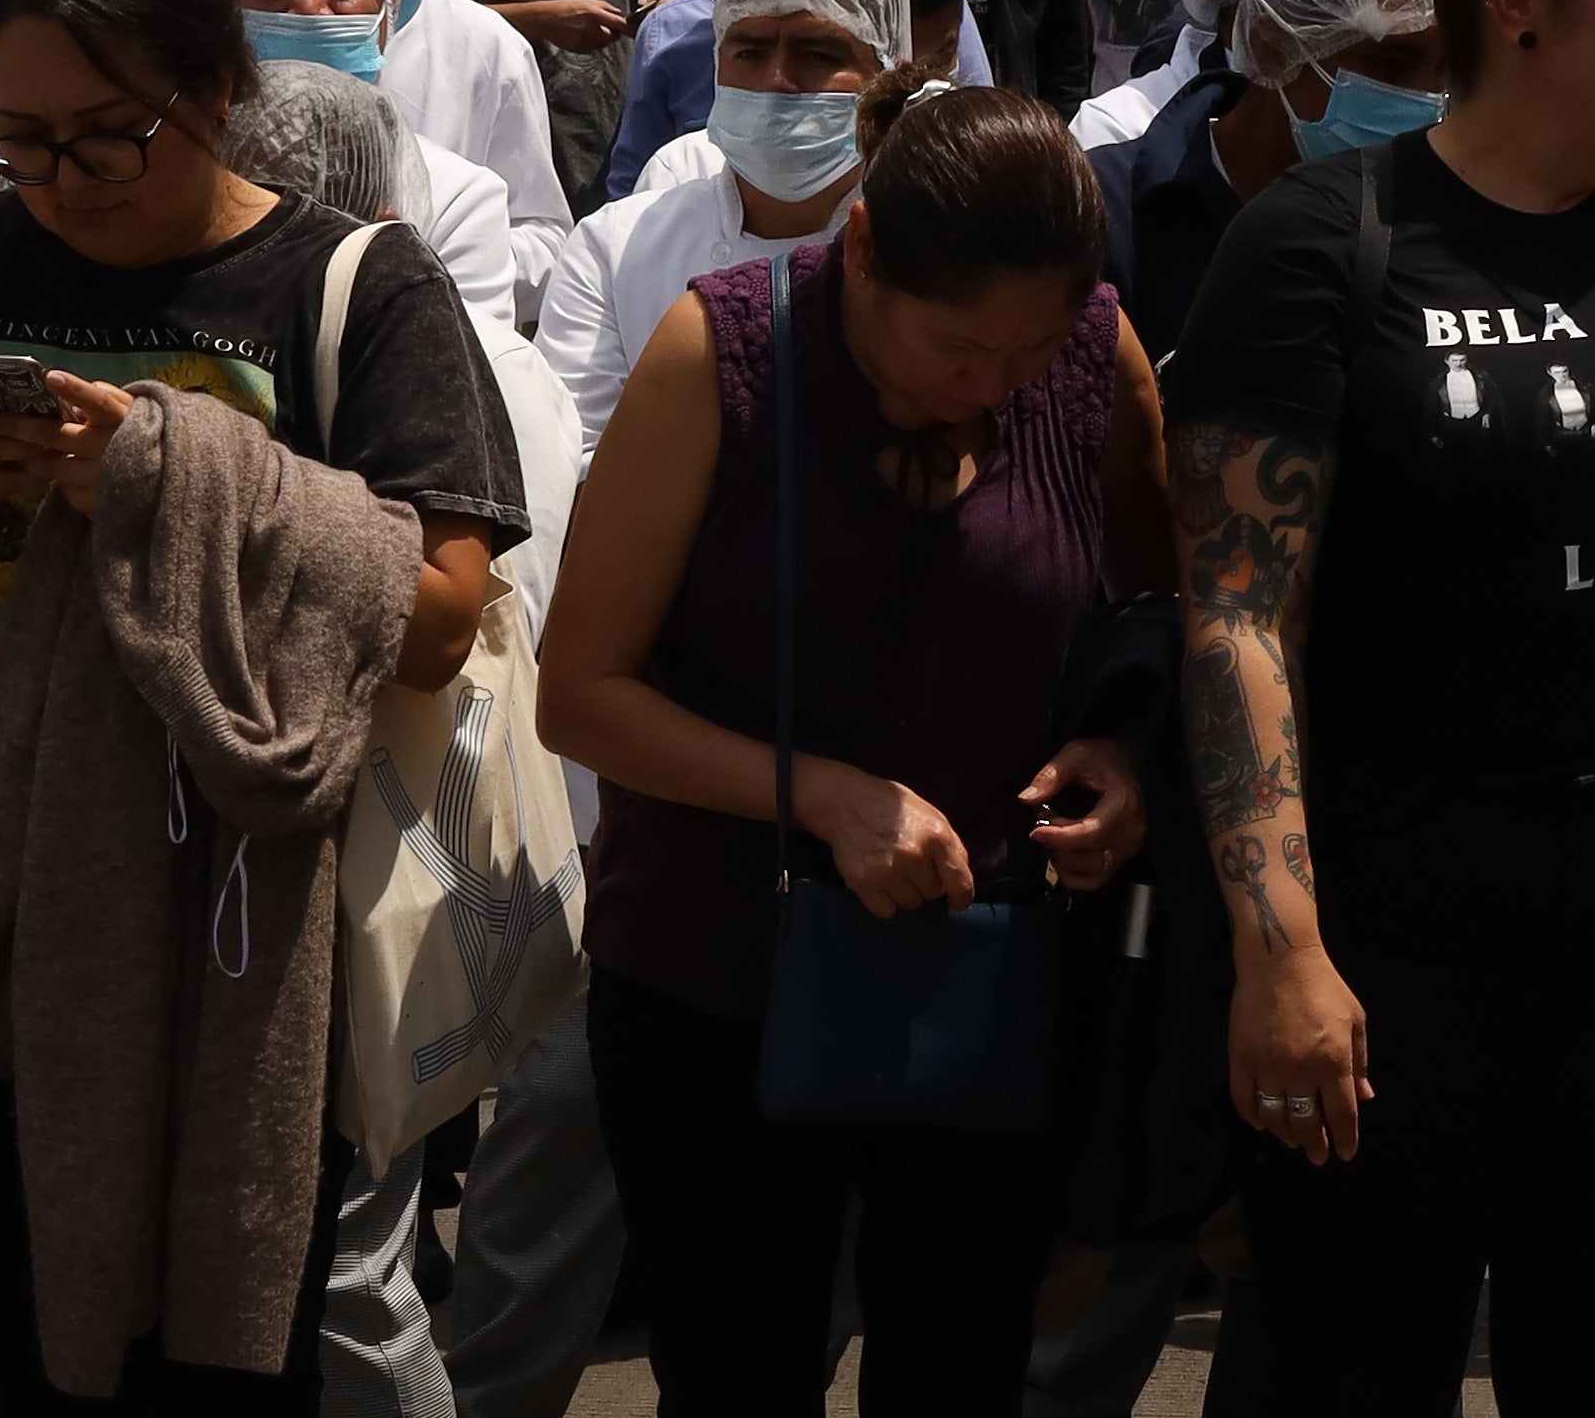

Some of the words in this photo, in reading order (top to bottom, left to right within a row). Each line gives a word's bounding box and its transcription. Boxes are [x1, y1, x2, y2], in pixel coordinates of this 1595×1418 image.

[1422, 302, 1589, 347] BELA
[123, 326, 181, 347] VAN
[191, 329, 278, 367] GOGH
